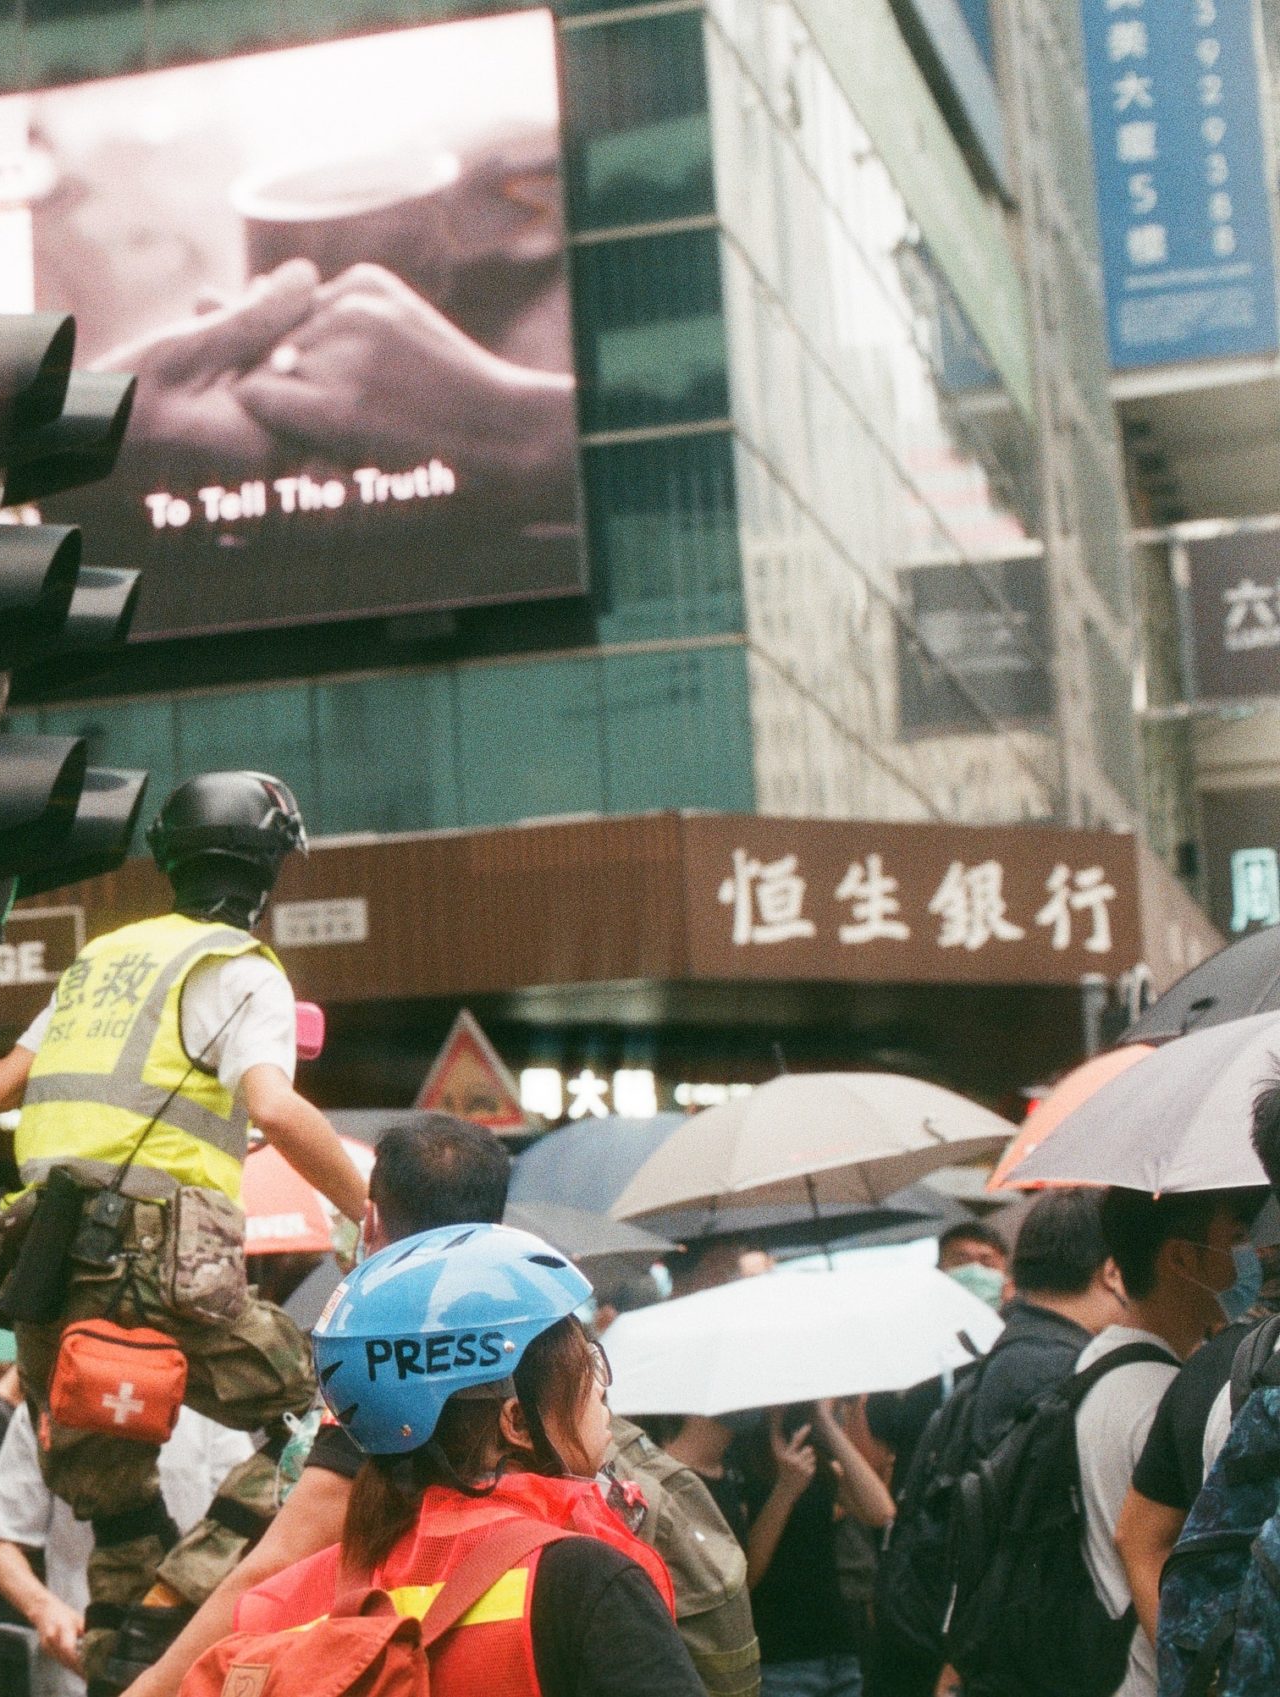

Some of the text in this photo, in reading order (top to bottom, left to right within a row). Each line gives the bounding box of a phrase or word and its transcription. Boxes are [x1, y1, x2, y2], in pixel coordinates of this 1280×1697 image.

[145, 458, 456, 529] To Tell The Truth
[718, 847, 1117, 953] 恒生銀行
[86, 1011, 135, 1039] aid
[365, 1331, 507, 1382] PRESS
